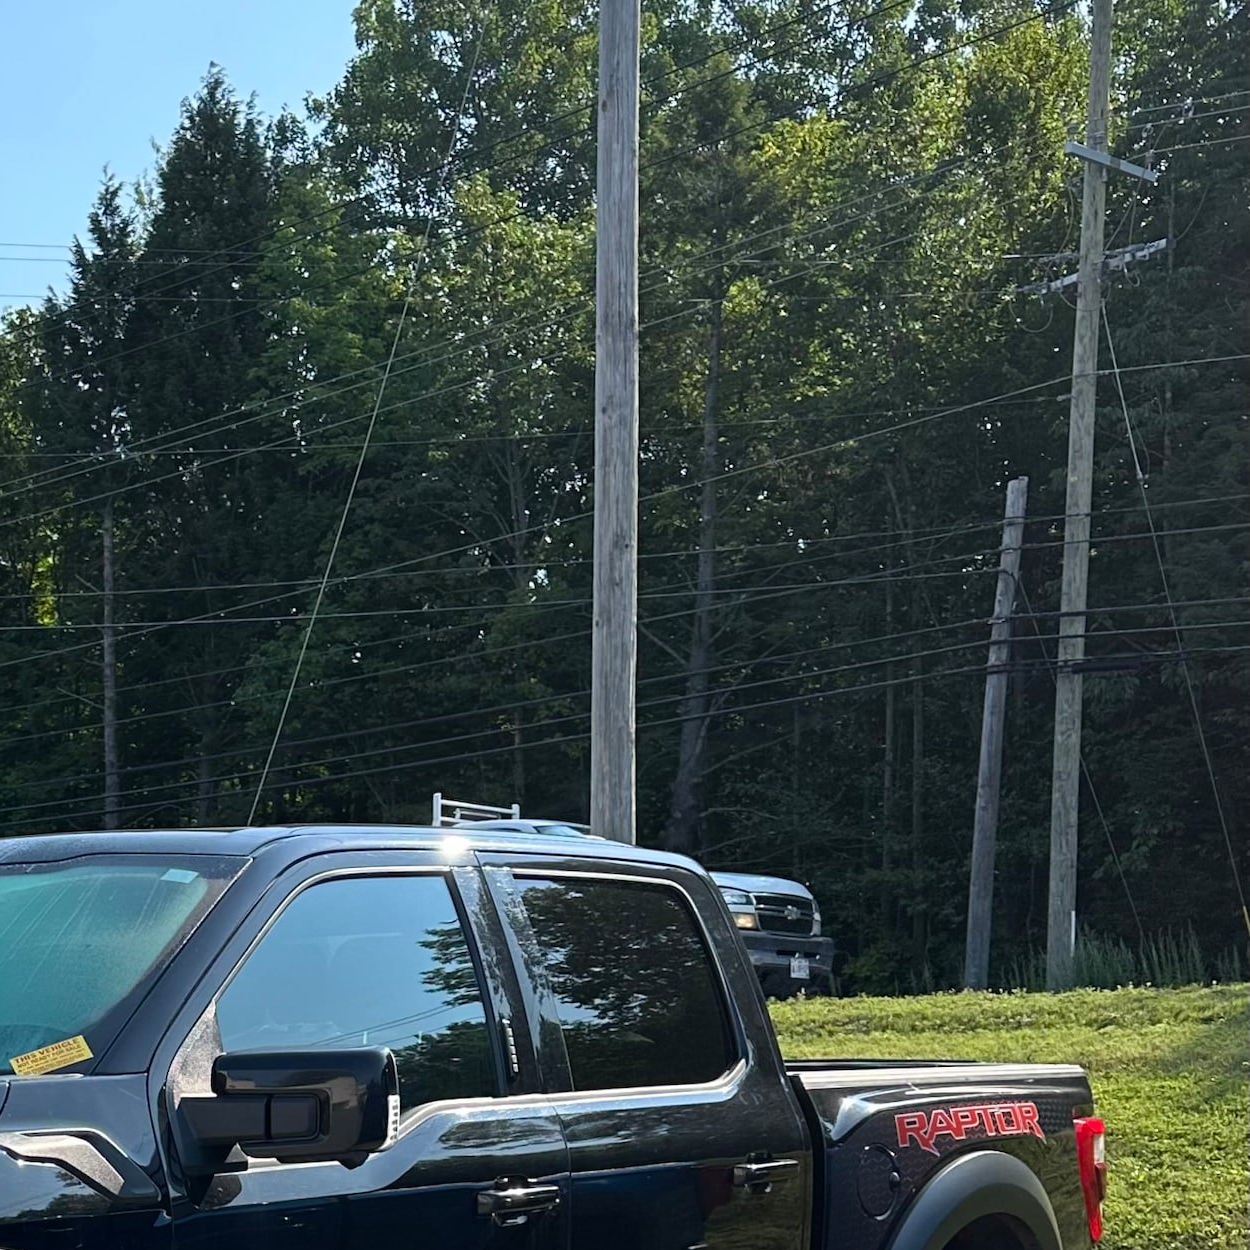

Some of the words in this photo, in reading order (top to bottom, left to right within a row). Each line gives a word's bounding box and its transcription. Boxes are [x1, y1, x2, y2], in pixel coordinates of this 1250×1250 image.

[15, 1053, 37, 1064] THIS
[38, 1038, 79, 1055] VEHICLE
[30, 1054, 51, 1064] READY
[66, 1044, 81, 1052] SALE
[894, 1102, 1047, 1157] RAPTOR
